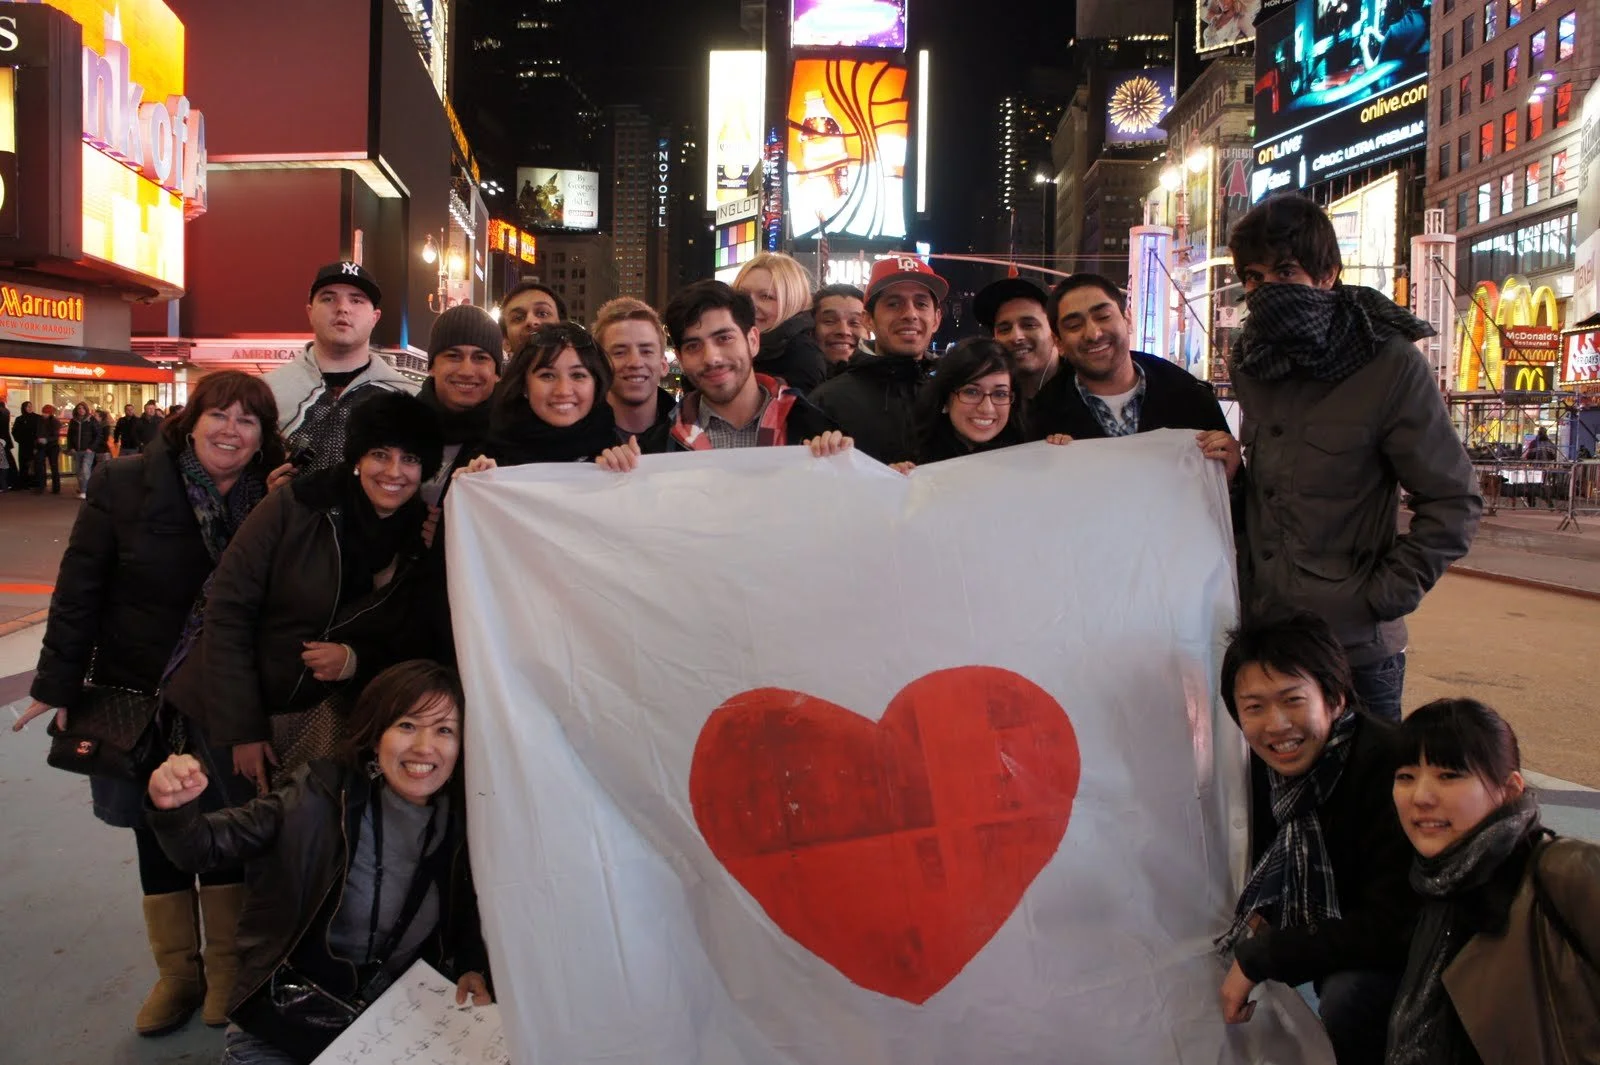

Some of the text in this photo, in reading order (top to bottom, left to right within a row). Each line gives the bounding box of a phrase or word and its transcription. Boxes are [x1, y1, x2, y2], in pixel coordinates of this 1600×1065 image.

[658, 151, 668, 227] NOVOTEL
[716, 197, 759, 219] INGLOT
[341, 261, 360, 276] NY
[0, 286, 82, 321] Marriott
[0, 320, 76, 335] NEW YORK MARQUIS
[1506, 331, 1558, 341] McDonald's
[232, 350, 301, 360] AMERICA
